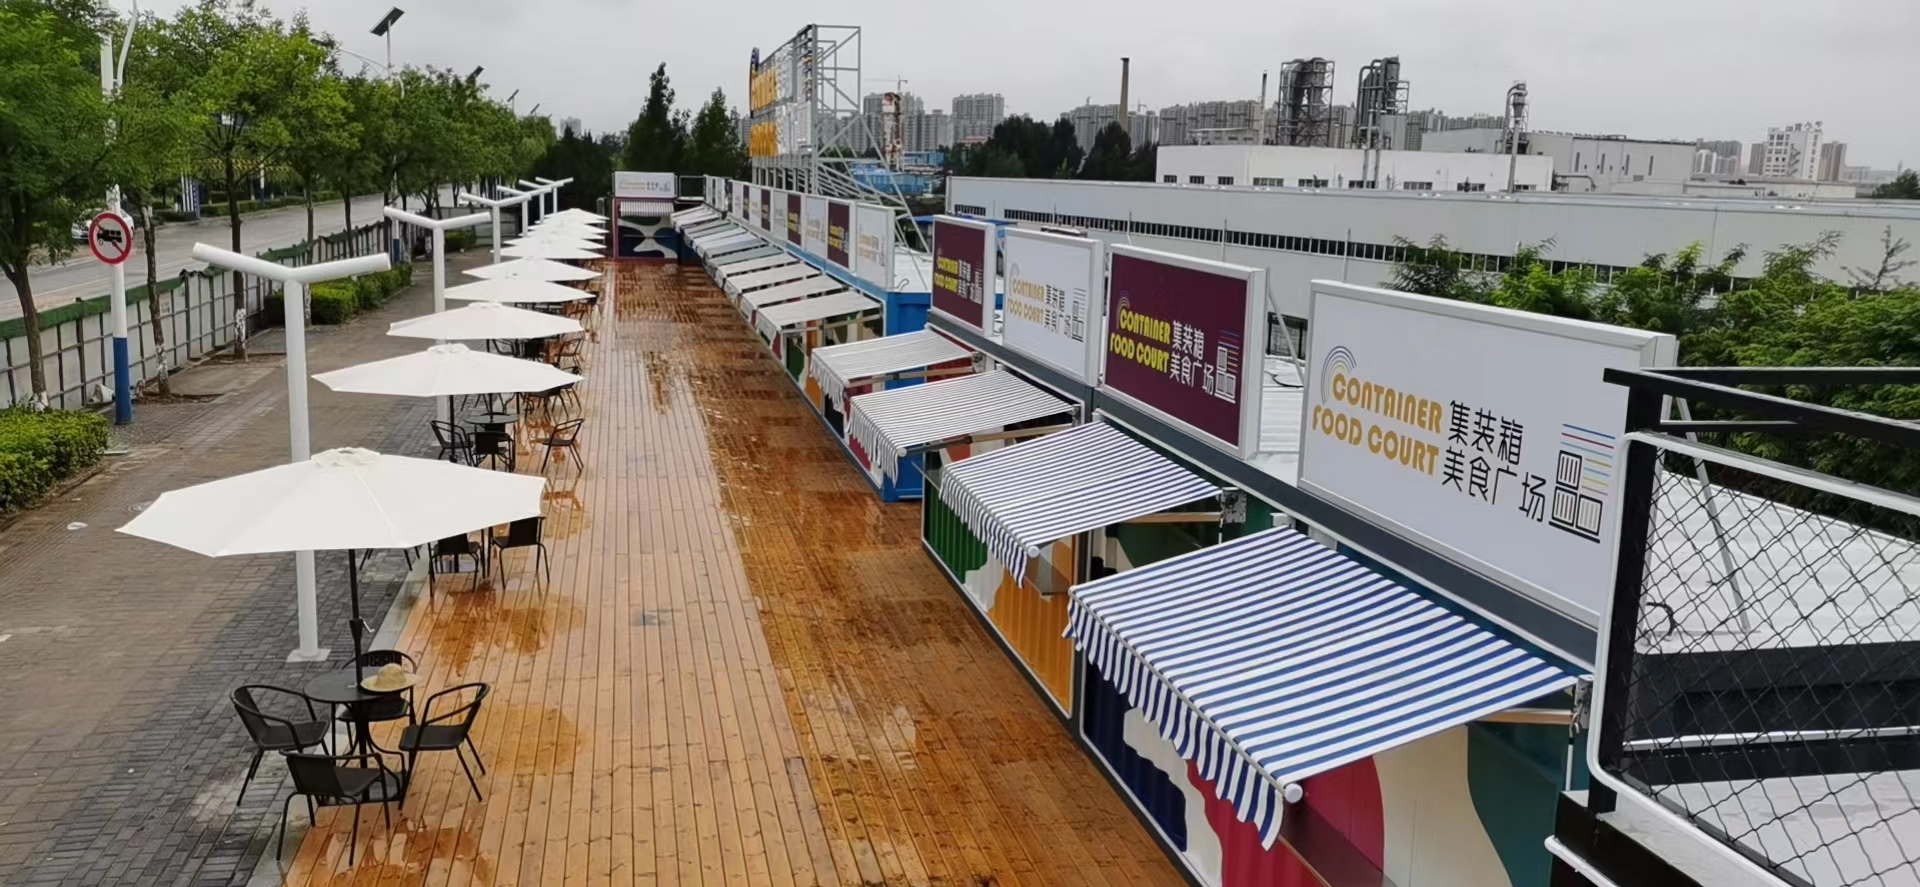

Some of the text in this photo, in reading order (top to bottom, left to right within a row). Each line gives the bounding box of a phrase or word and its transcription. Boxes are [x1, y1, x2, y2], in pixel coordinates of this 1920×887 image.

[1120, 308, 1171, 345] CONTAINER
[1172, 320, 1204, 360] 集装箱
[1110, 333, 1170, 373] FOOD COURT
[1169, 351, 1214, 395] 美食广场
[1332, 373, 1443, 434] CONTAINER
[1312, 404, 1440, 476] FOOD COURT
[1448, 400, 1524, 466] 集装箱
[1442, 446, 1547, 523] 美食广场
